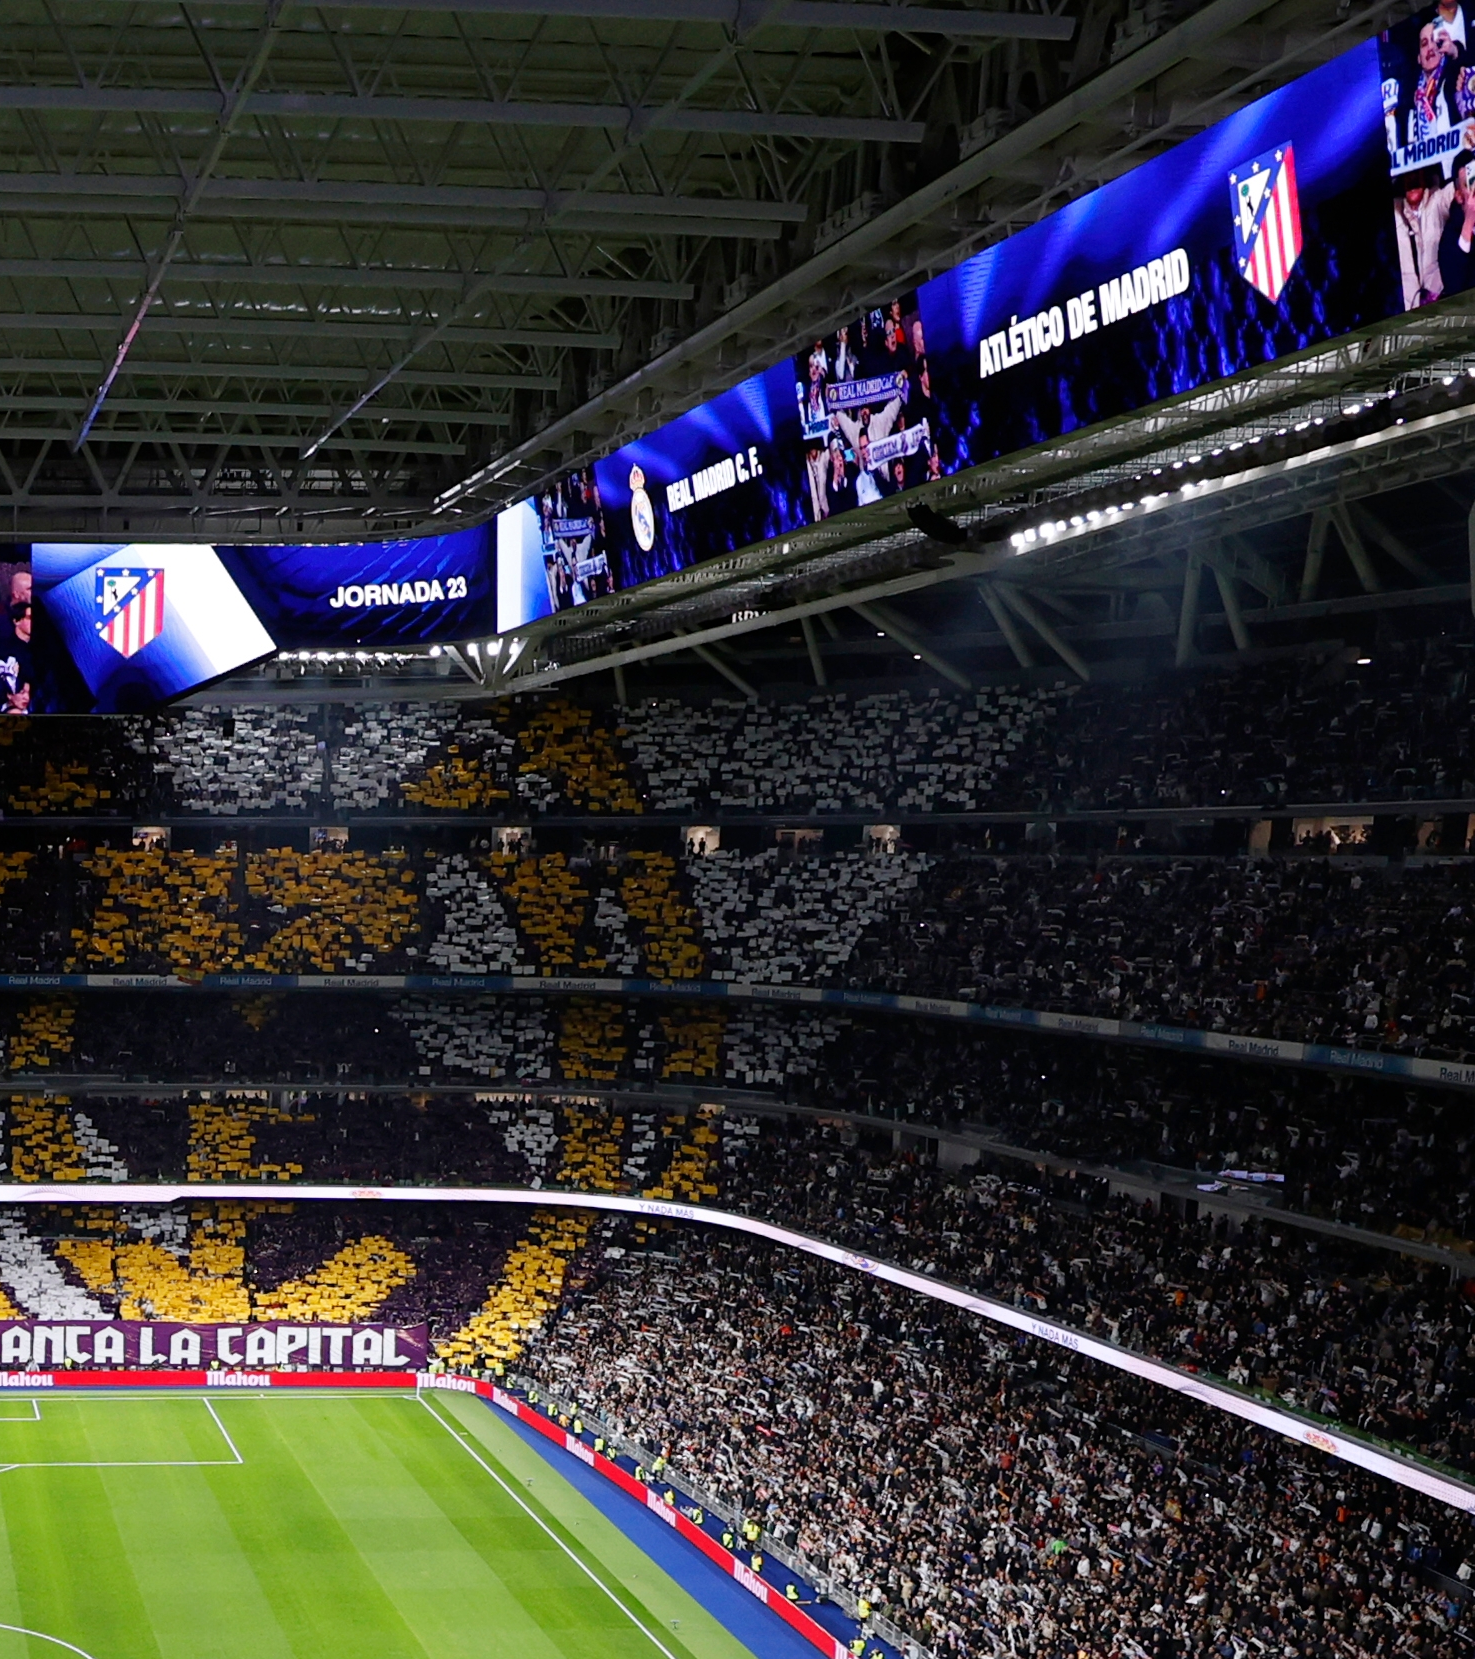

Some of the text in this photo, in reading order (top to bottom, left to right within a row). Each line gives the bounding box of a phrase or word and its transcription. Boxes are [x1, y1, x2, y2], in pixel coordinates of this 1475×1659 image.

[1404, 130, 1460, 164] MADRID
[980, 248, 1190, 378] ATLÉTICO DE MADRID
[667, 483, 694, 512] REAL
[694, 457, 736, 503] MADRID
[329, 575, 467, 609] JORNADA 23
[8, 976, 60, 985] Real Madrid
[113, 977, 167, 986] Real Madrid
[220, 977, 272, 986] Real Madrid
[324, 978, 379, 987] Real Madrid
[432, 977, 485, 987] Real Madrid
[540, 980, 596, 990] Real Madrid
[751, 988, 801, 999] Real Madrid
[1229, 1039, 1279, 1056] Real Madrid
[1330, 1050, 1384, 1069] Real Madrid
[1440, 1067, 1460, 1081] Real
[639, 1203, 645, 1211] Y
[647, 1204, 673, 1215] NADA
[1031, 1322, 1037, 1333] Y
[1038, 1325, 1060, 1343] NADA
[139, 1326, 201, 1365] LA
[217, 1326, 411, 1367] CAPITAL
[206, 1372, 271, 1388] Mahou
[416, 1372, 476, 1393] Mahou
[647, 1488, 676, 1528] Mahou
[733, 1557, 768, 1604] Mahou
